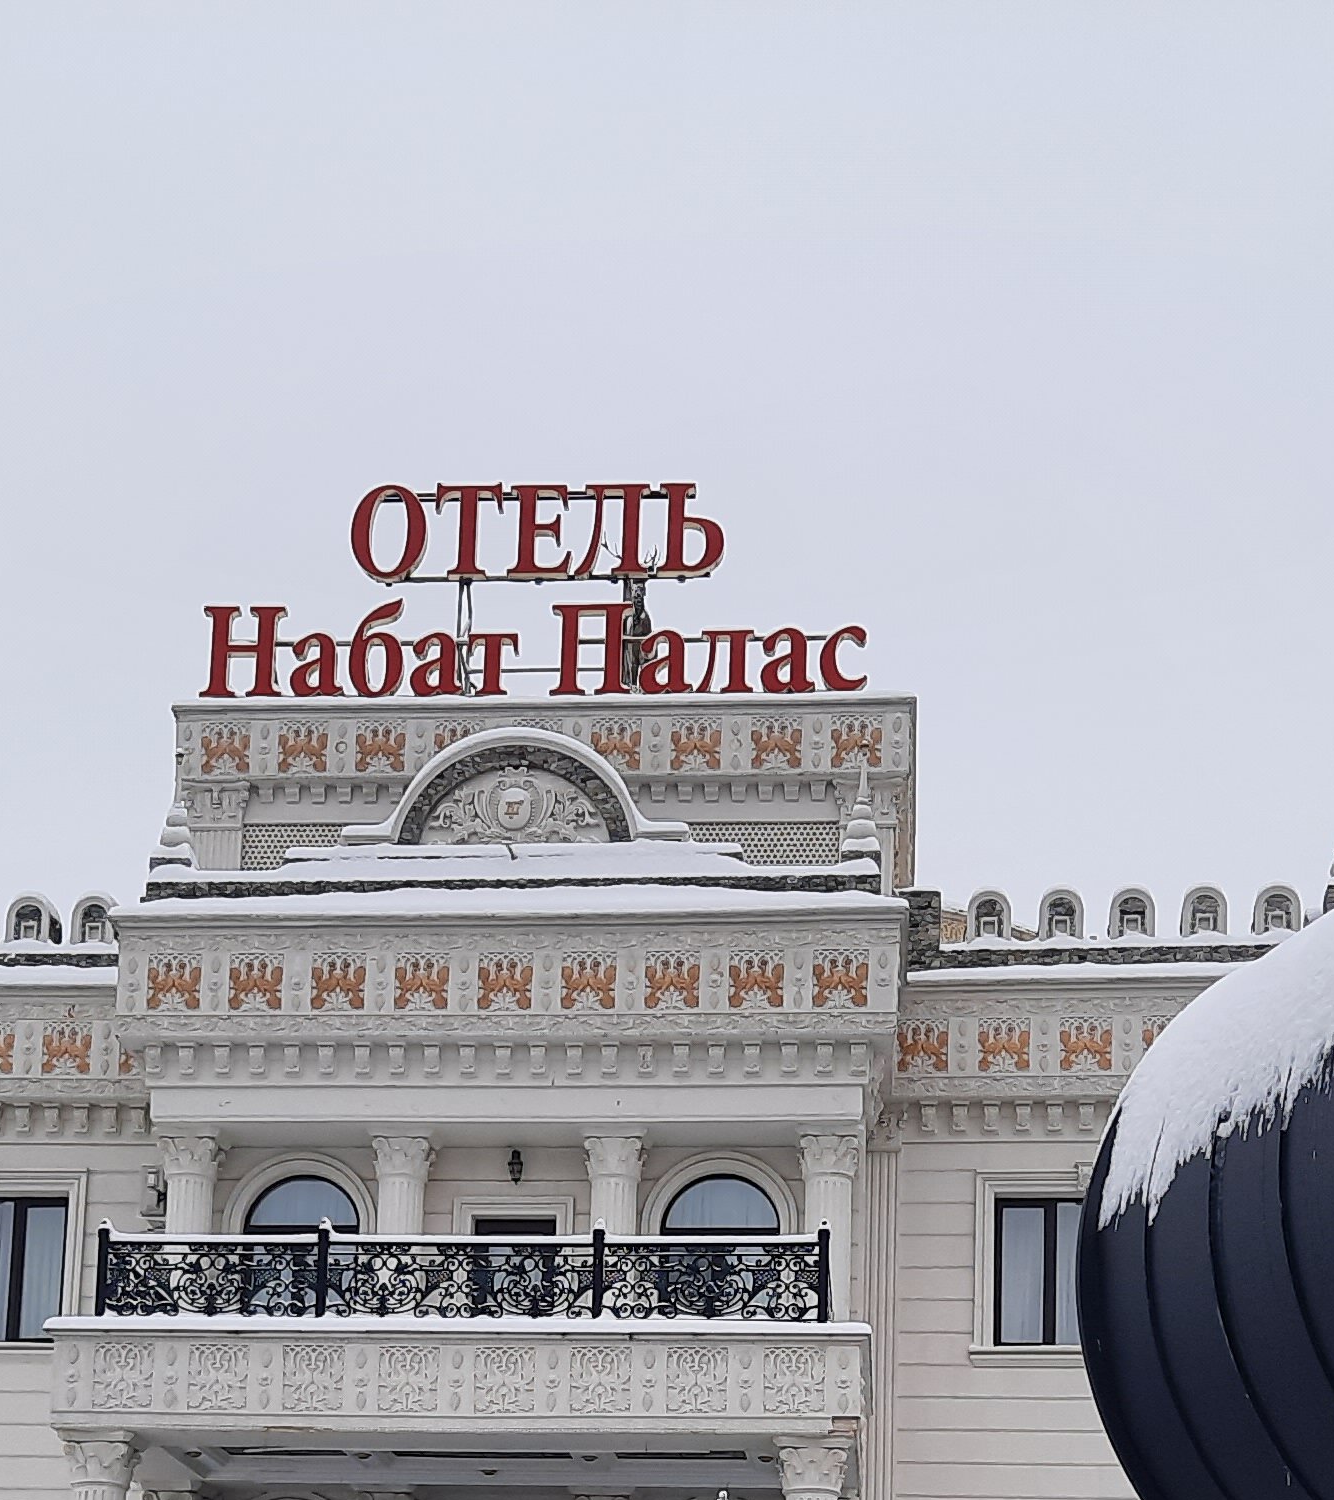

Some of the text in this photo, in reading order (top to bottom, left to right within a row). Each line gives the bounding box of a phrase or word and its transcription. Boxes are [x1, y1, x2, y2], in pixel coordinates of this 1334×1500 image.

[351, 483, 724, 578] ОТЕЛЬ
[199, 598, 867, 697] Набат Палас
